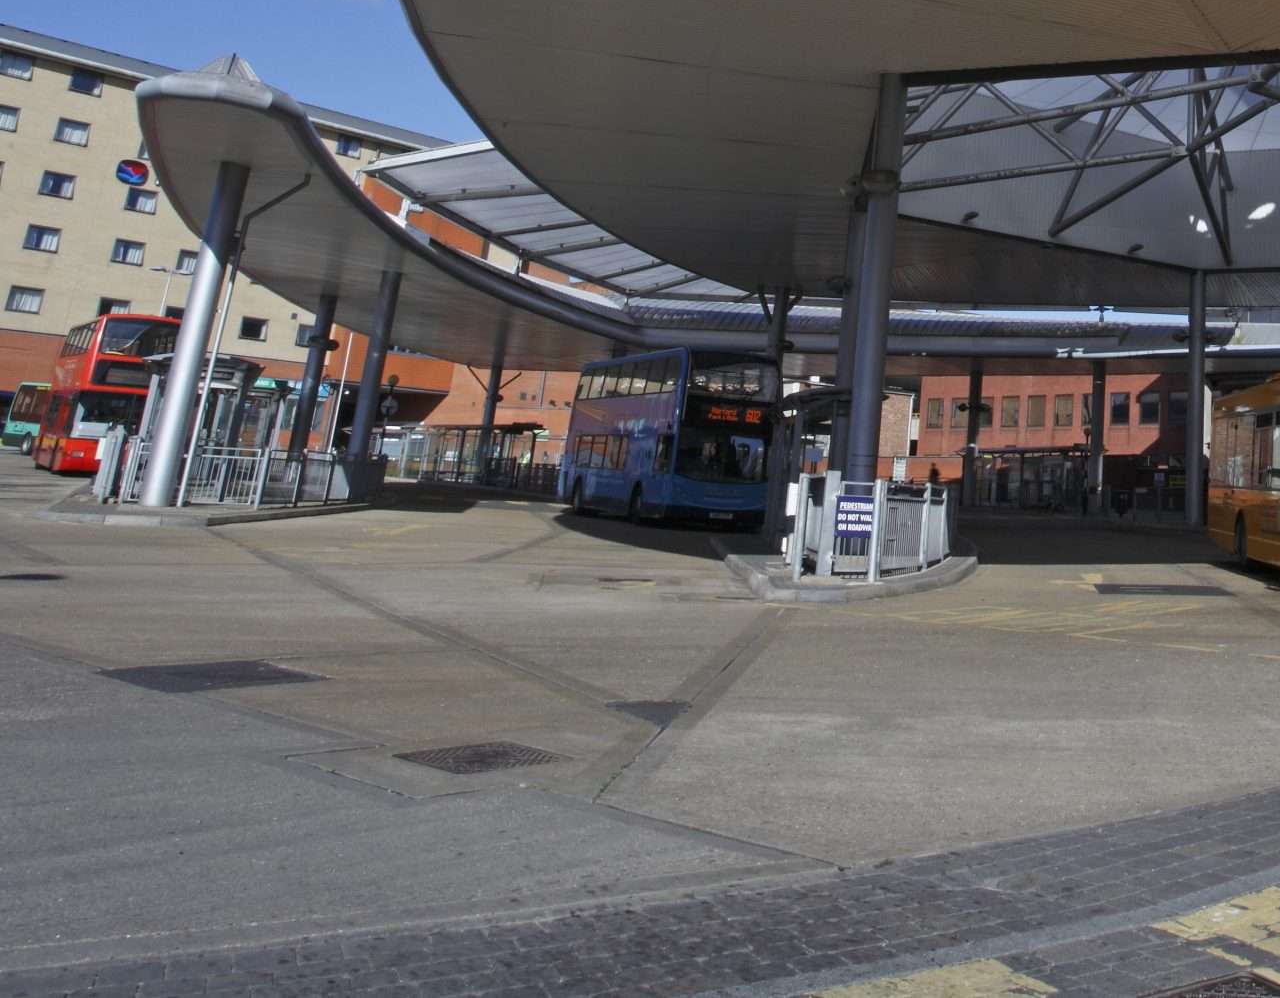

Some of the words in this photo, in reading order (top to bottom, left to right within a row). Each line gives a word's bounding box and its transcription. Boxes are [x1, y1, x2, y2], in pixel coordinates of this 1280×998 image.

[840, 502, 873, 510] PEDESTRIAN
[837, 513, 847, 521] DO
[847, 513, 860, 521] NOT
[860, 514, 873, 522] WAL
[838, 523, 847, 531] ON
[847, 523, 873, 532] ROADWA
